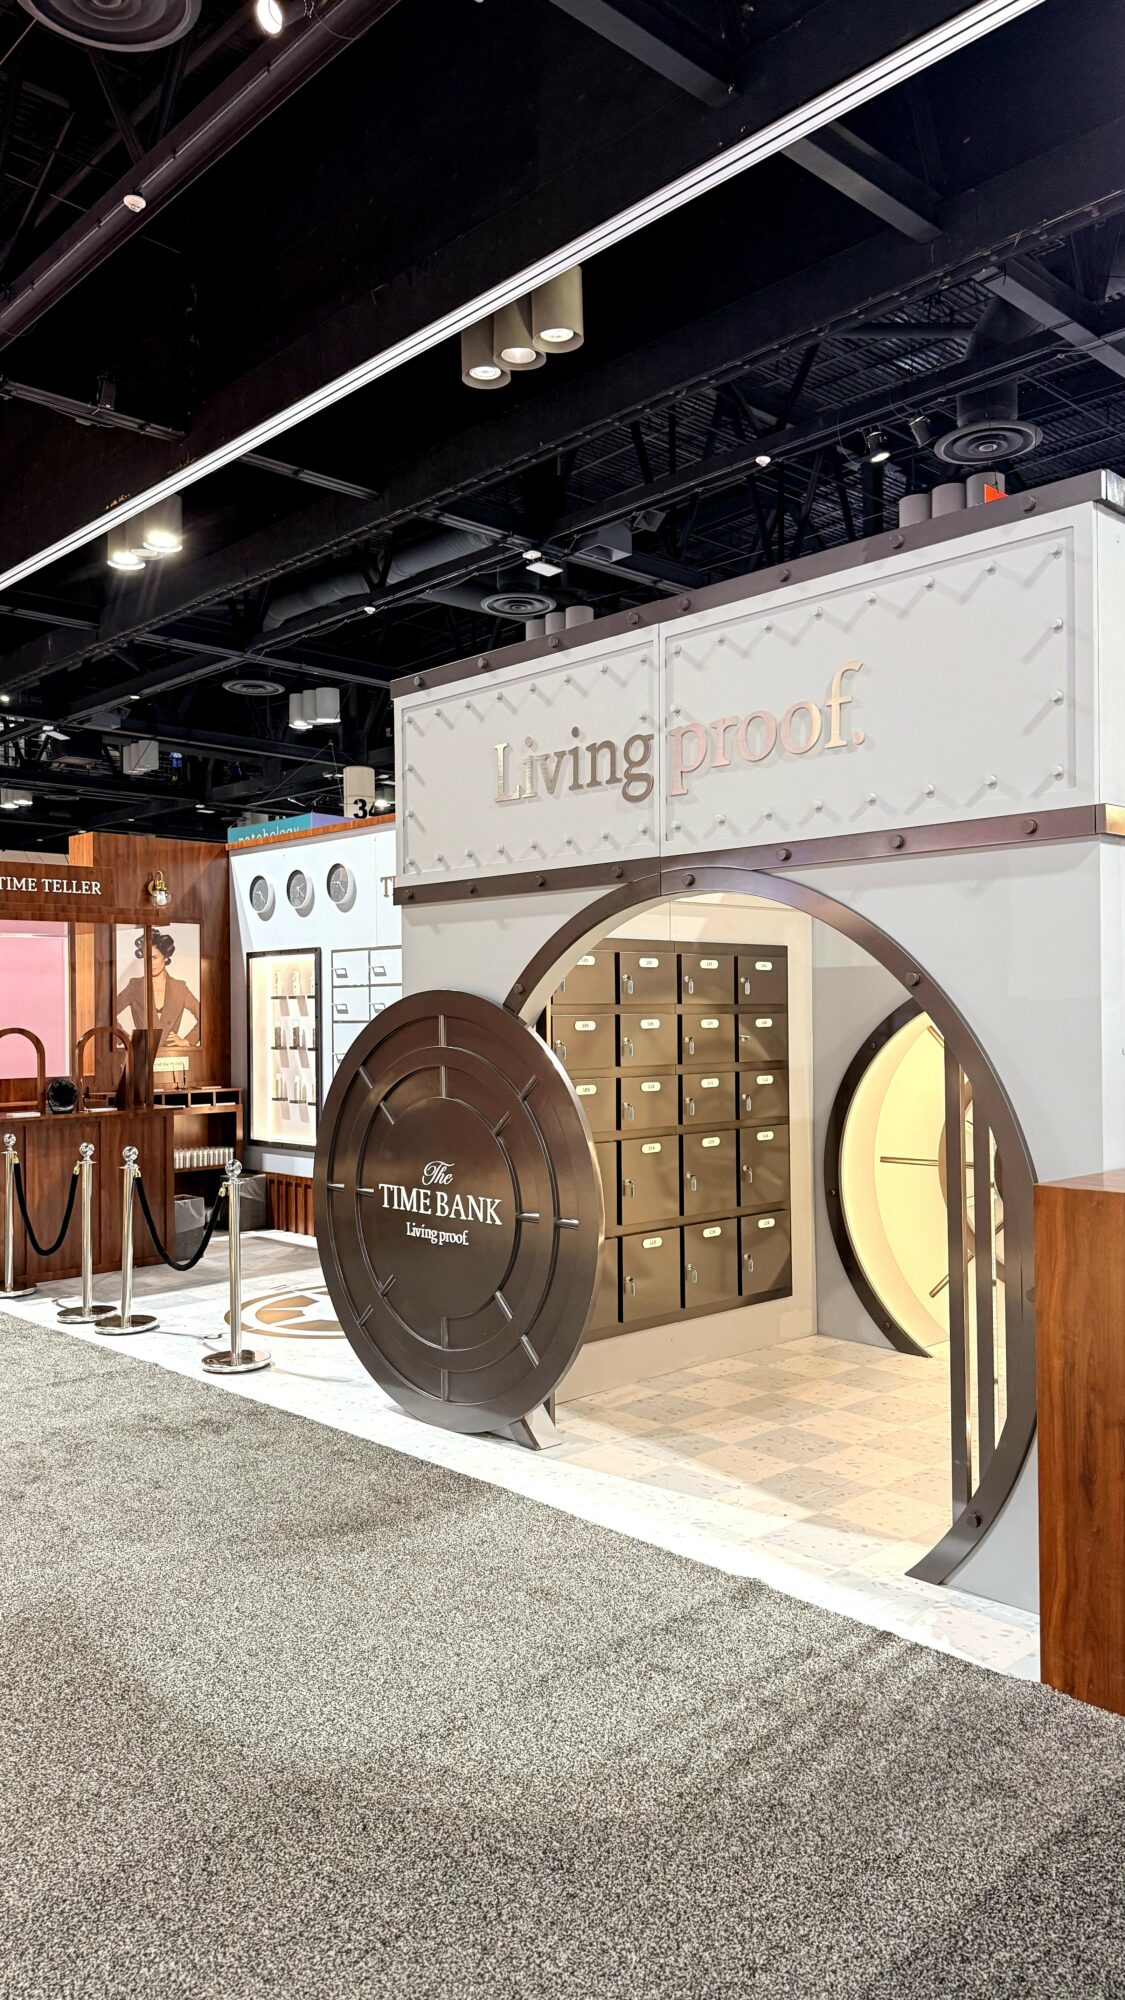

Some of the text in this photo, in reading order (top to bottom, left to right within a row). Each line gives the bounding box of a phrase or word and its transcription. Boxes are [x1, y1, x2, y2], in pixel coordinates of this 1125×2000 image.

[493, 659, 867, 803] Living proof.
[0, 876, 102, 895] TIME TELLER
[422, 1160, 455, 1186] The
[379, 1184, 503, 1226] TIME BANK
[405, 1221, 470, 1246] Living proof.
